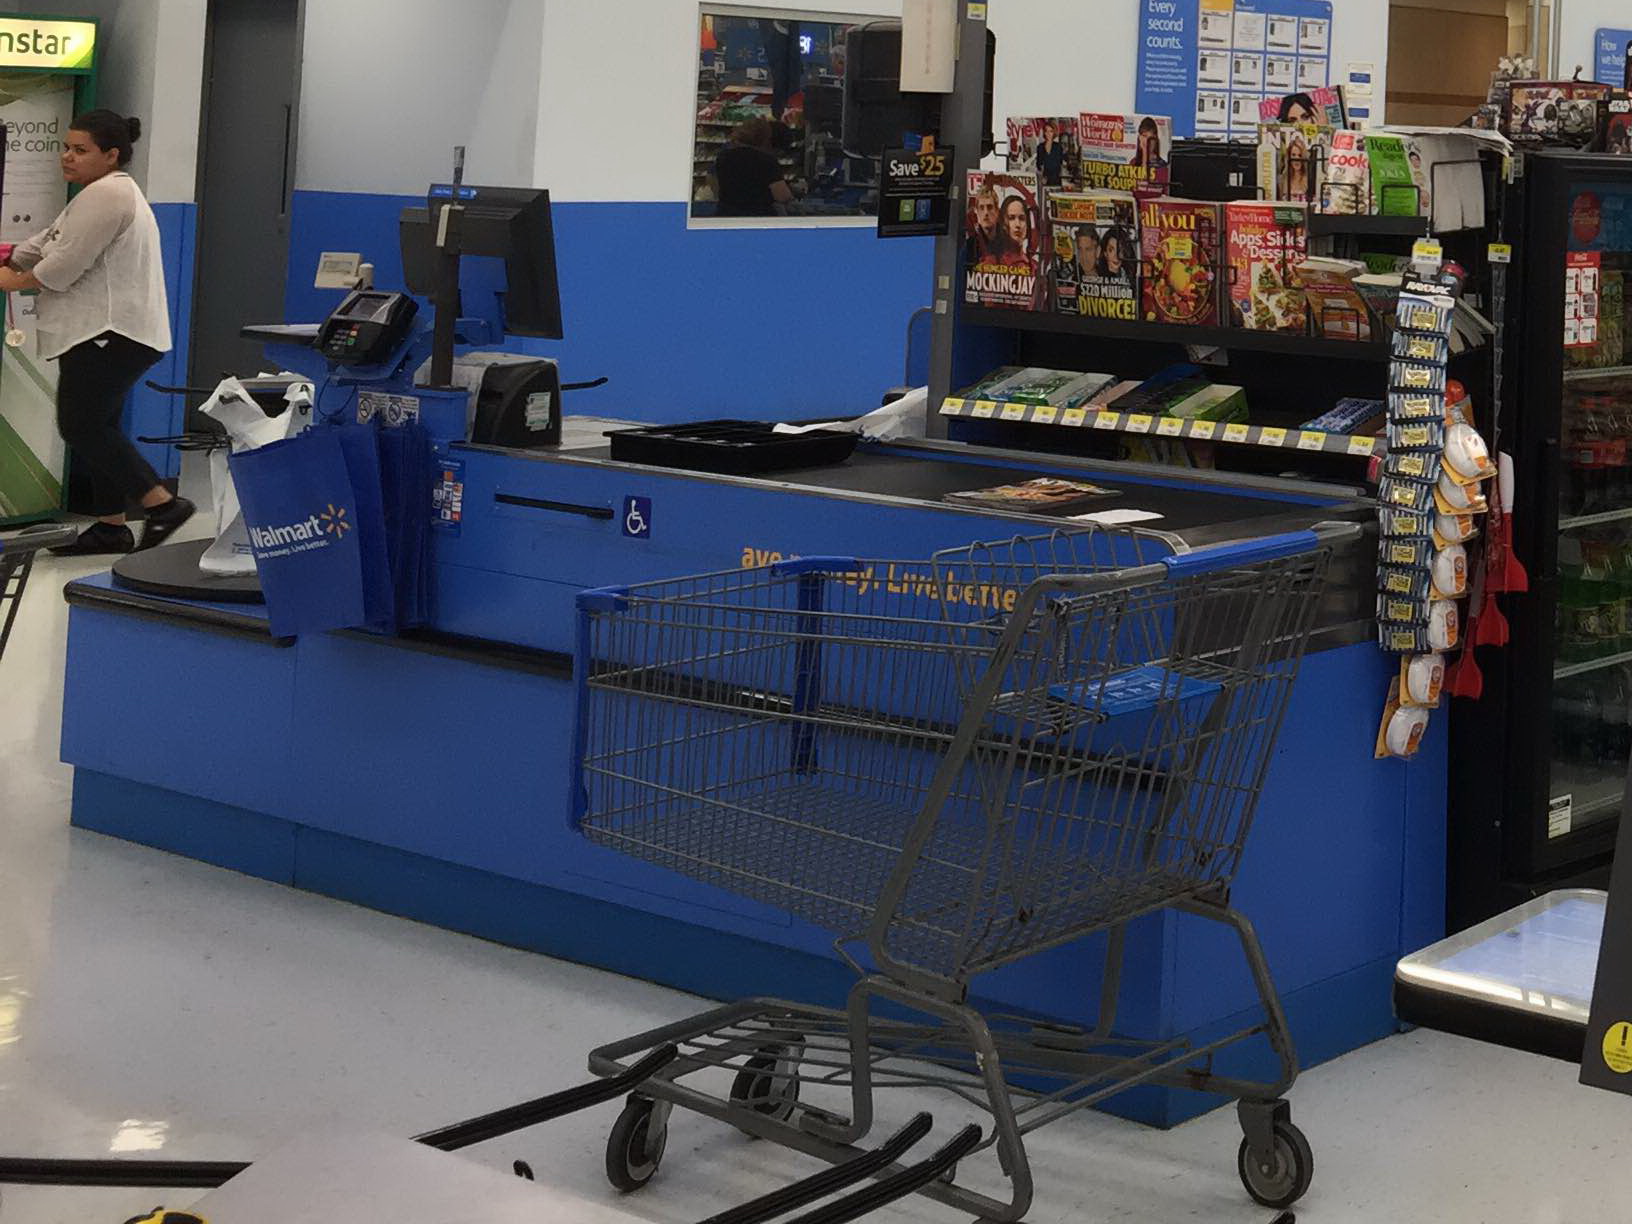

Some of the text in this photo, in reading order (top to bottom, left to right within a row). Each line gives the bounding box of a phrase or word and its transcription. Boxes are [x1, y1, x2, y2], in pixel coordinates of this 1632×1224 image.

[1147, 17, 1184, 33] second
[1146, 35, 1184, 50] counts.
[0, 116, 59, 139] eyond
[1083, 126, 1112, 142] World
[25, 136, 62, 153] coin
[889, 155, 945, 176] Save $25
[1083, 161, 1116, 176] TURBO
[1141, 204, 1160, 228] all
[1159, 213, 1195, 233] you
[966, 271, 1036, 295] MOCKINGJAY
[1080, 283, 1133, 298] $220 Million
[1079, 295, 1137, 319] DIVORCE!
[250, 515, 324, 549] Walmart
